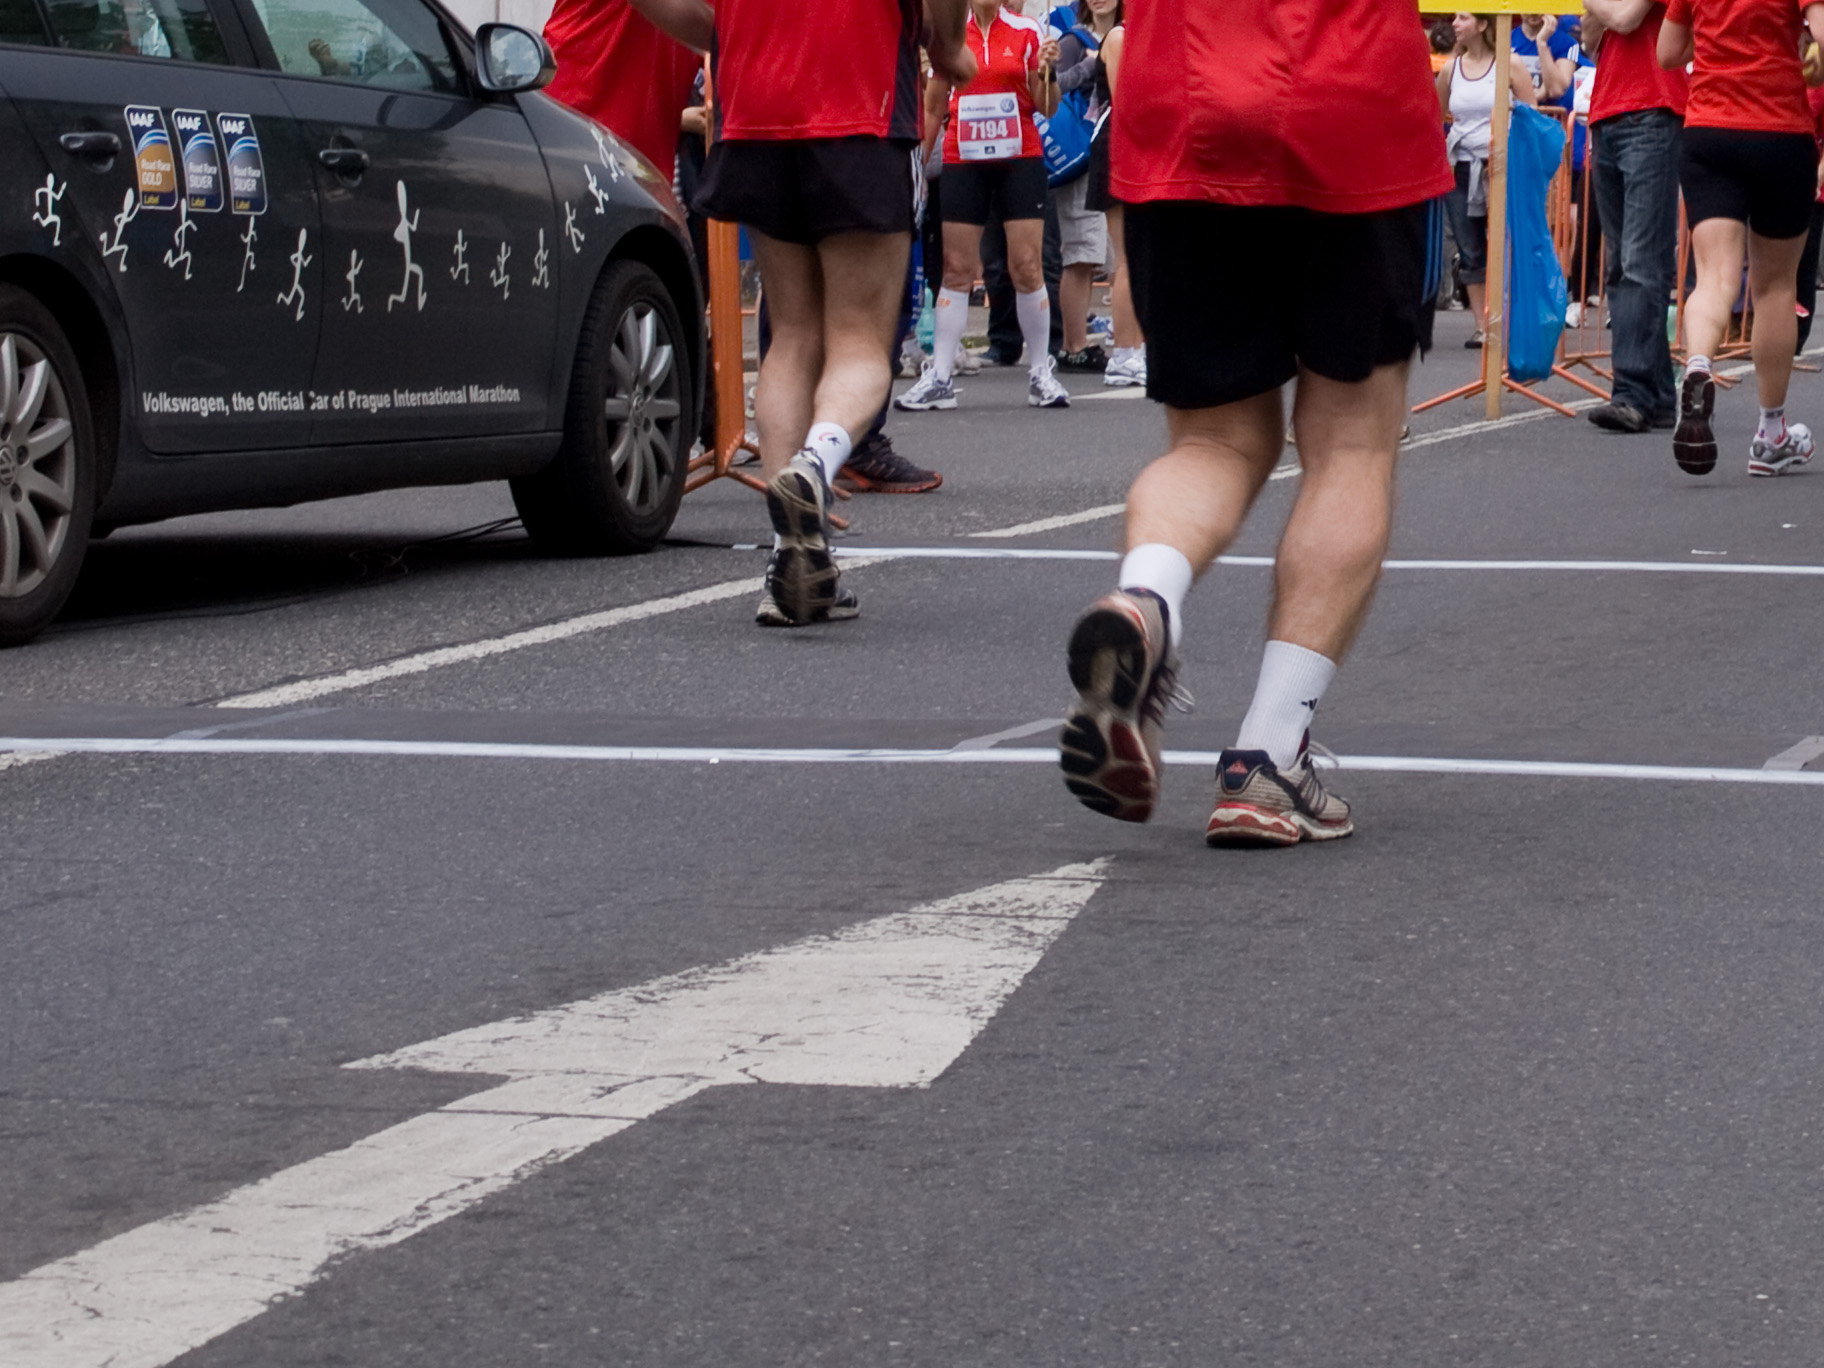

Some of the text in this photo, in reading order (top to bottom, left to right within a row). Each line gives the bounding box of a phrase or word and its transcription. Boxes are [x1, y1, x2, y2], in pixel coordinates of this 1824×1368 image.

[129, 112, 155, 128] IAAF
[177, 115, 202, 131] IAAF
[221, 119, 246, 135] IAAF
[968, 119, 1008, 140] 7194
[141, 158, 171, 171] Road Race
[188, 162, 217, 175] Road Race
[233, 165, 261, 178] Road Race
[141, 172, 162, 186] GOLD
[188, 175, 213, 189] SILVER
[234, 179, 257, 192] SILVER
[143, 195, 160, 205] Label
[191, 197, 206, 208] Label
[235, 200, 250, 210] Label
[142, 391, 230, 417] Volkswagen,
[231, 392, 255, 412] the
[257, 390, 304, 412] Official
[332, 389, 345, 410] of
[347, 389, 391, 414] Prague
[393, 385, 467, 408] International
[468, 384, 520, 404] Marathon
